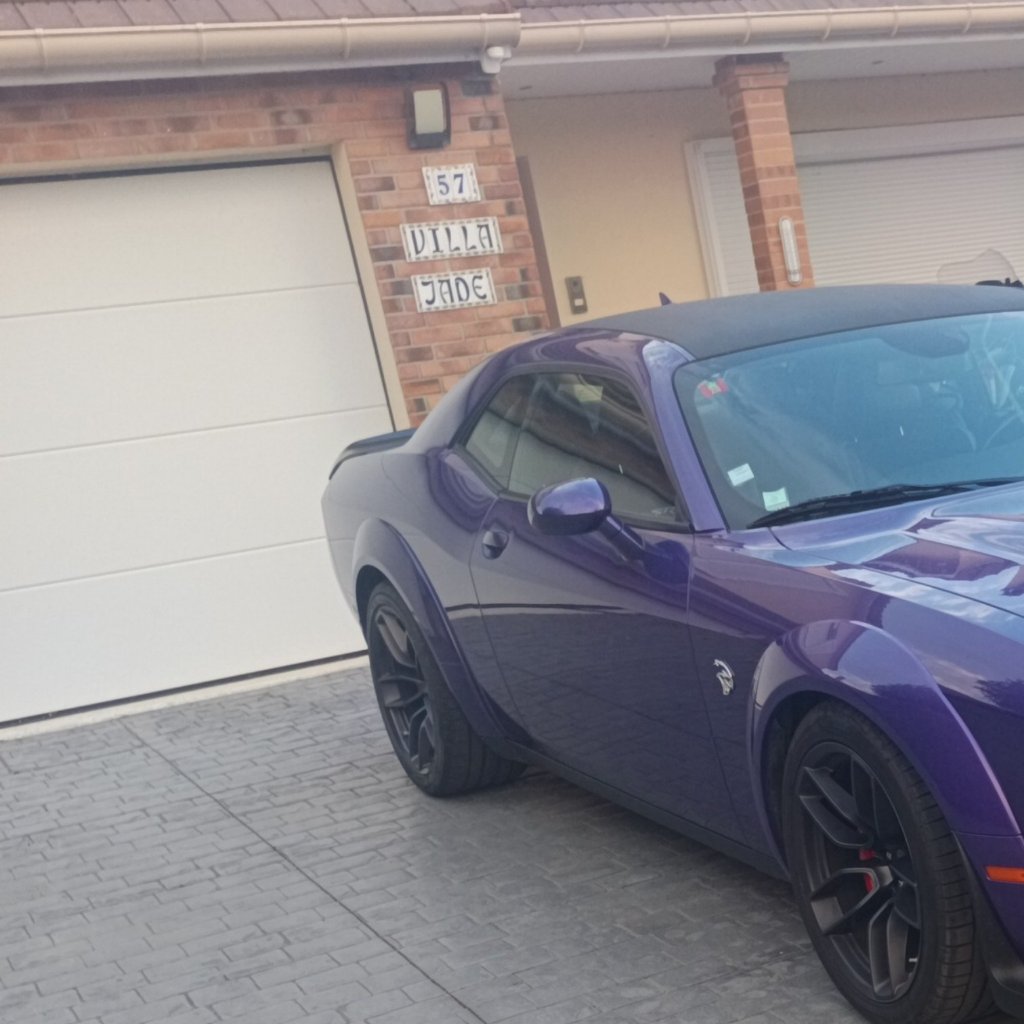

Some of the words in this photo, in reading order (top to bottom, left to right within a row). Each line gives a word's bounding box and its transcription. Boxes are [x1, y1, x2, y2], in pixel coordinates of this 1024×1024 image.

[437, 173, 465, 195] 57
[411, 223, 494, 255] VILLA
[421, 275, 487, 305] JADE
